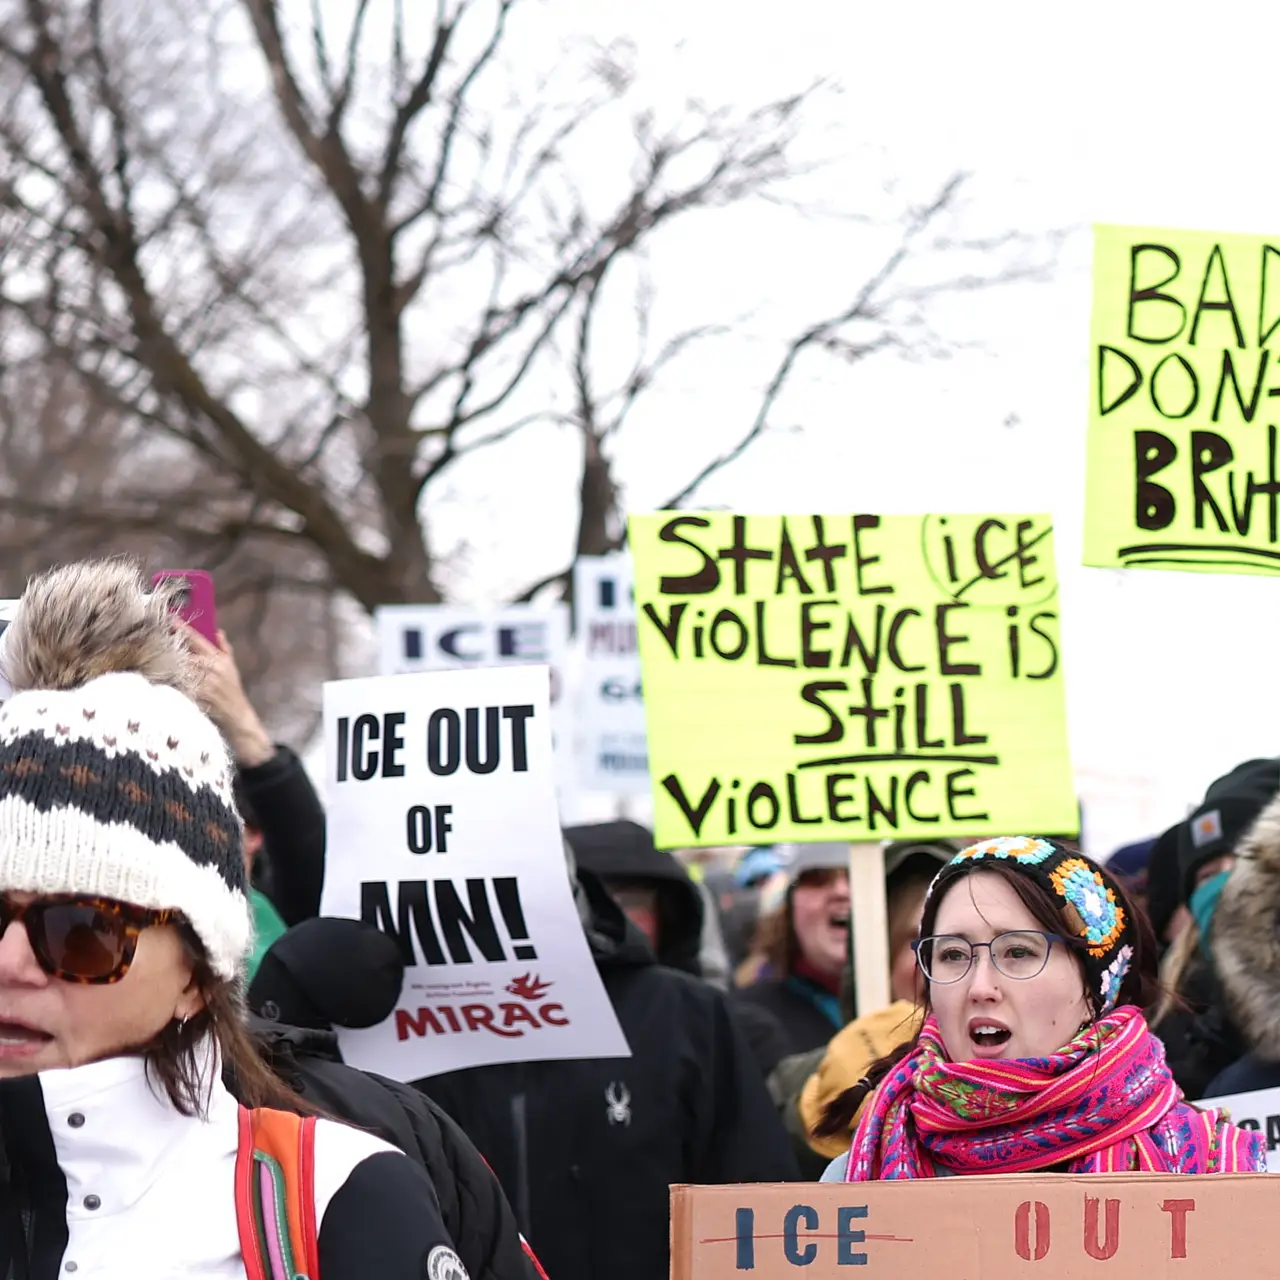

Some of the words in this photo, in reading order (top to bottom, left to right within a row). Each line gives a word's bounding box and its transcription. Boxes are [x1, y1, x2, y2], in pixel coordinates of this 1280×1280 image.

[402, 621, 546, 661] ICE
[336, 712, 406, 783] ICE
[427, 704, 535, 776] OUT
[406, 804, 453, 855] OF
[360, 876, 539, 967] MN!
[394, 1001, 570, 1042] MIRAC
[734, 1204, 870, 1271] ICE
[1014, 1196, 1197, 1263] OUT
